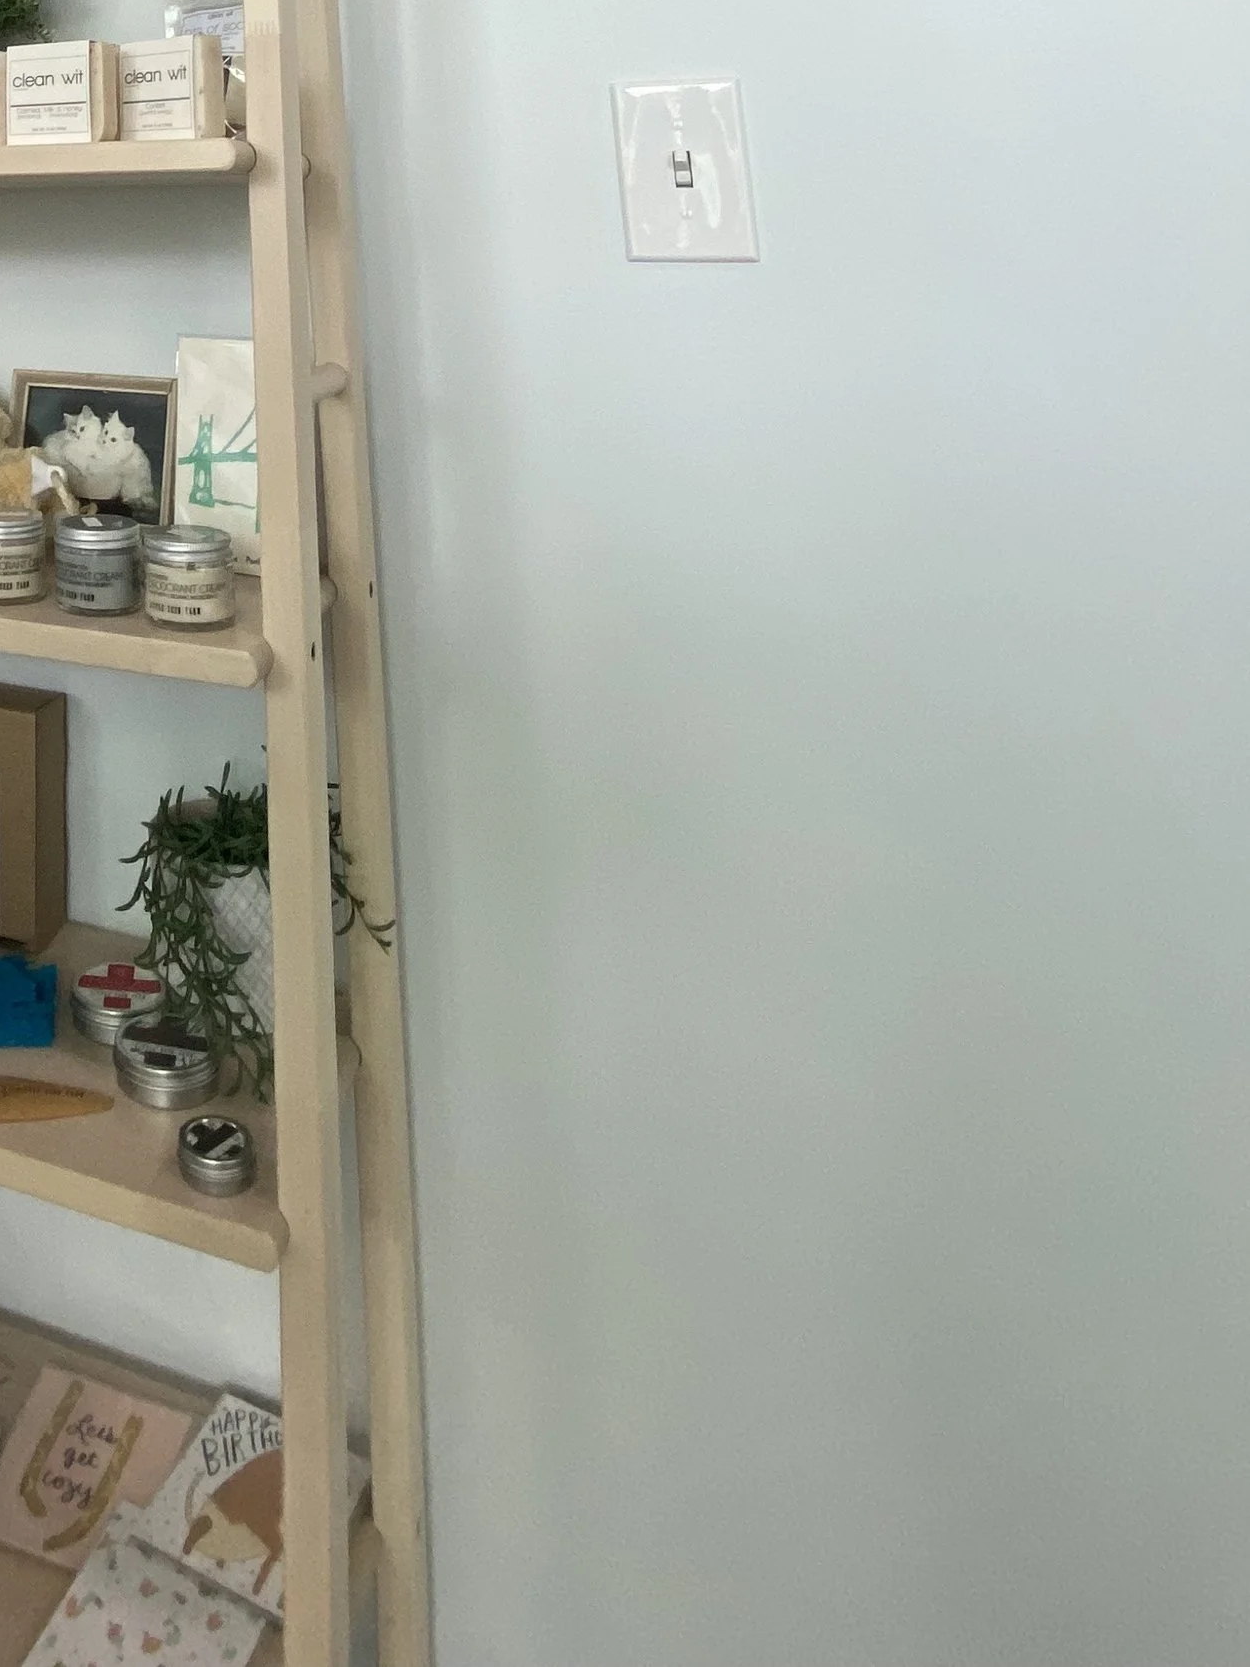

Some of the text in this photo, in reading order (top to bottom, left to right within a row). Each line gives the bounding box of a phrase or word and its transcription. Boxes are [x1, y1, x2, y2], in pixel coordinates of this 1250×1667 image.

[13, 69, 84, 88] clean wit
[124, 65, 187, 85] clean wit
